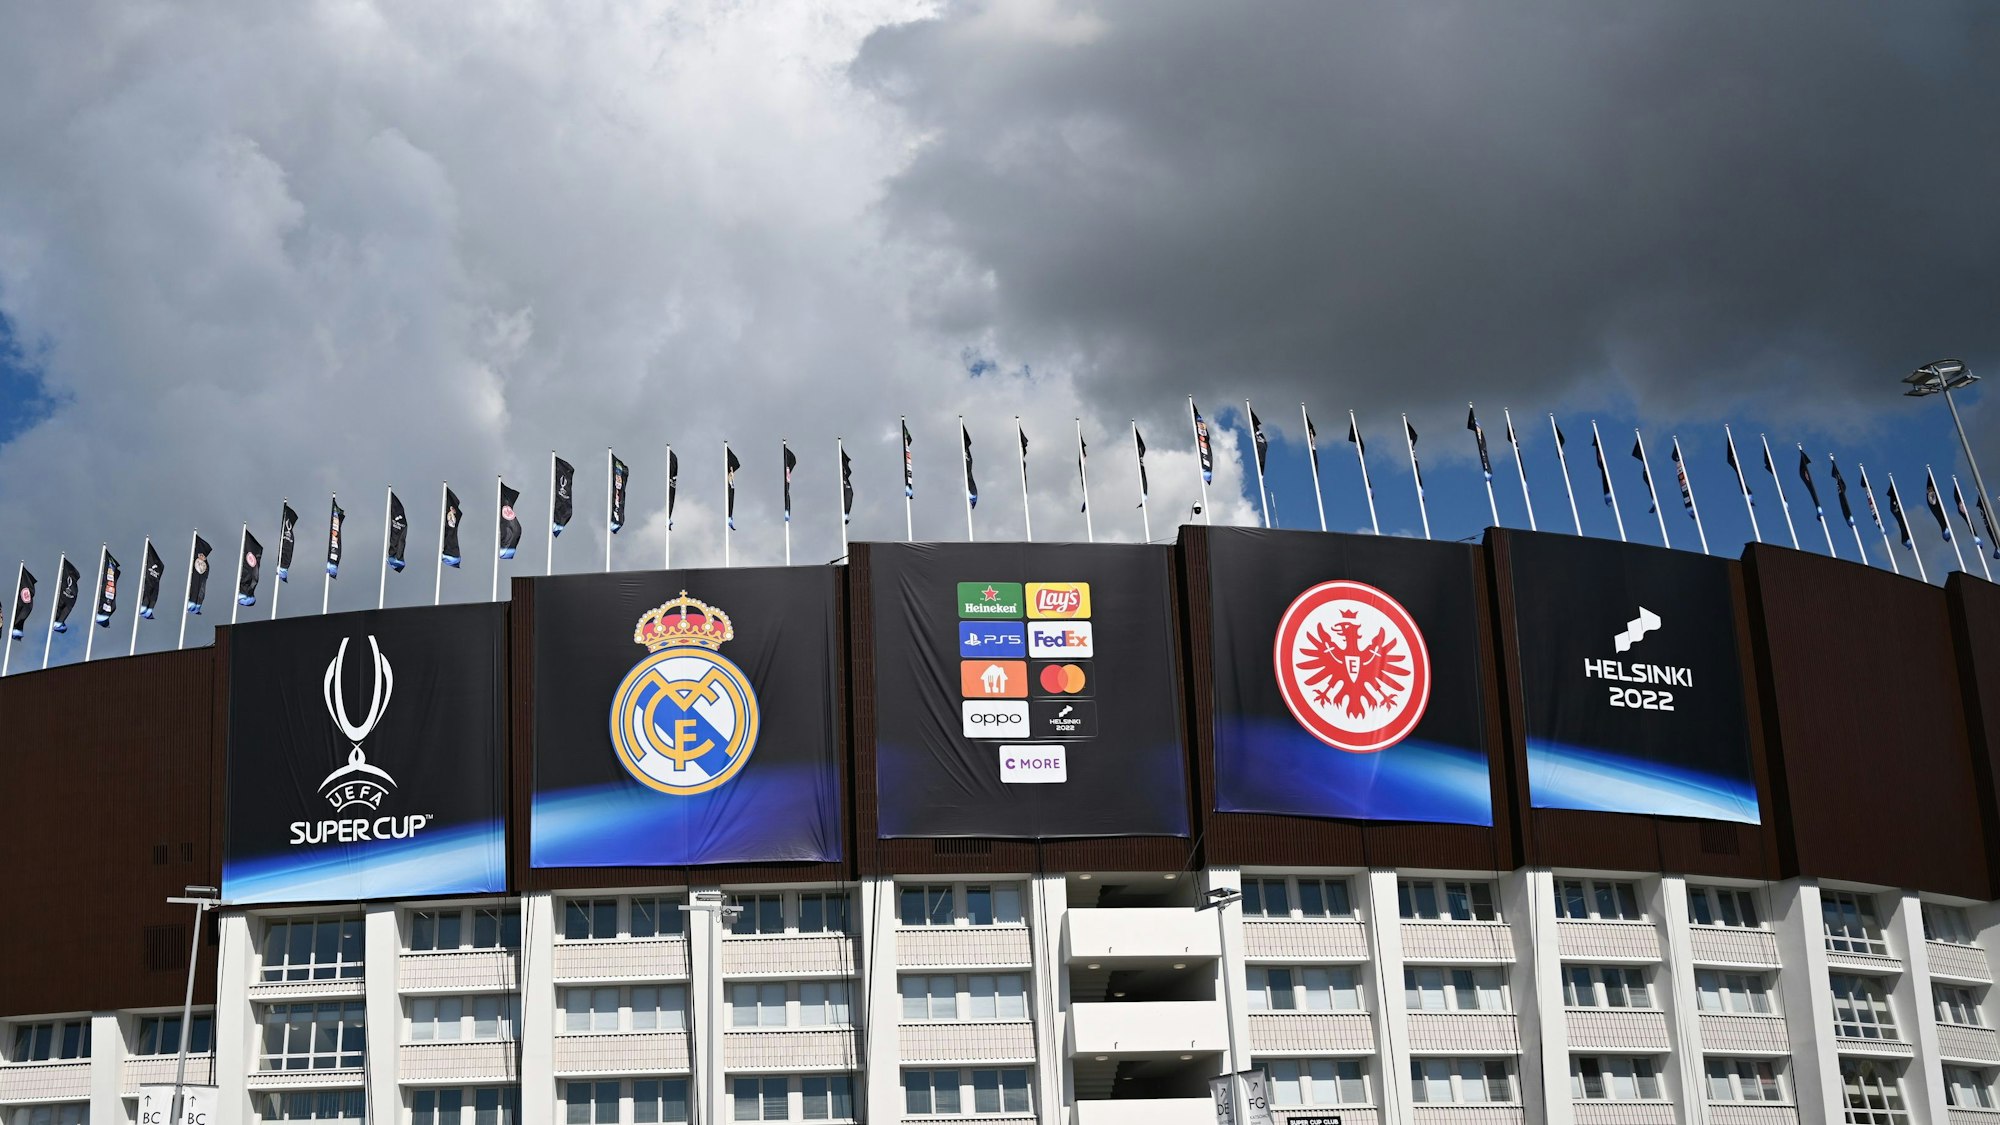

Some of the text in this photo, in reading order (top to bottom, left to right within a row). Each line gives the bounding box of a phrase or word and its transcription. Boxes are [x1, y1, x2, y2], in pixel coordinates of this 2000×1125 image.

[1039, 589, 1078, 612] Lay's
[965, 603, 1017, 613] Heineken
[984, 634, 1022, 645] PS5
[1034, 630, 1088, 648] FedEx
[1584, 658, 1693, 687] HELSINKI
[1609, 686, 1675, 711] 2022
[970, 713, 1022, 727] oppo
[1005, 758, 1061, 770] C MORE
[329, 785, 383, 808] UEFA
[289, 818, 372, 845] SUPER
[1217, 1102, 1230, 1116] DE
[1248, 1096, 1266, 1111] FG
[143, 1111, 161, 1124] BC
[187, 1112, 206, 1125] BC
